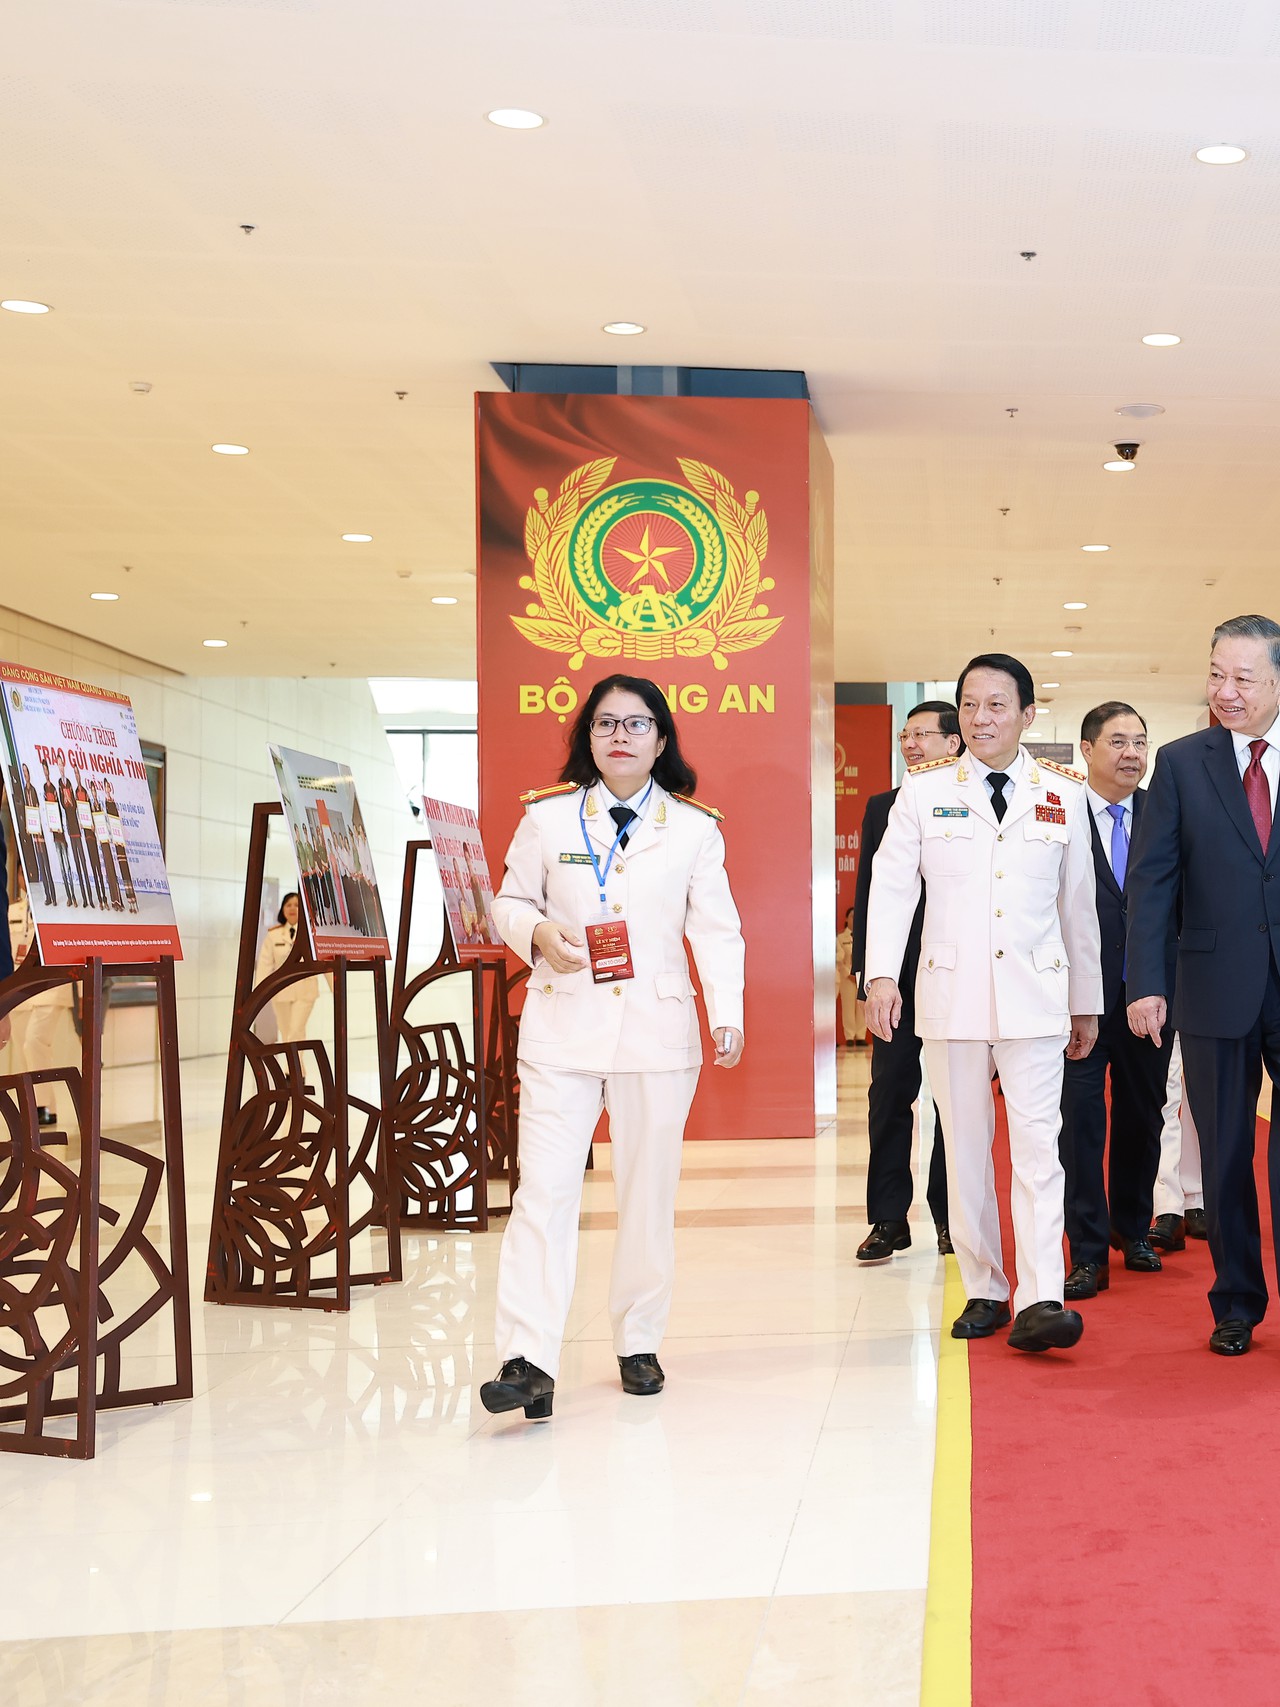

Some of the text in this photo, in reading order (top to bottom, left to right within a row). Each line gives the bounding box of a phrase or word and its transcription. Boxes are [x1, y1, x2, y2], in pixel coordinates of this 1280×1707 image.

[519, 676, 578, 724] BỘ
[718, 684, 775, 713] AN
[60, 720, 93, 743] CHƯƠNG
[92, 722, 118, 748] TRÌNH
[34, 744, 66, 768] TRAO
[67, 743, 89, 771] GỬI
[89, 751, 125, 777] NGHĨA
[838, 854, 855, 872] DÂN
